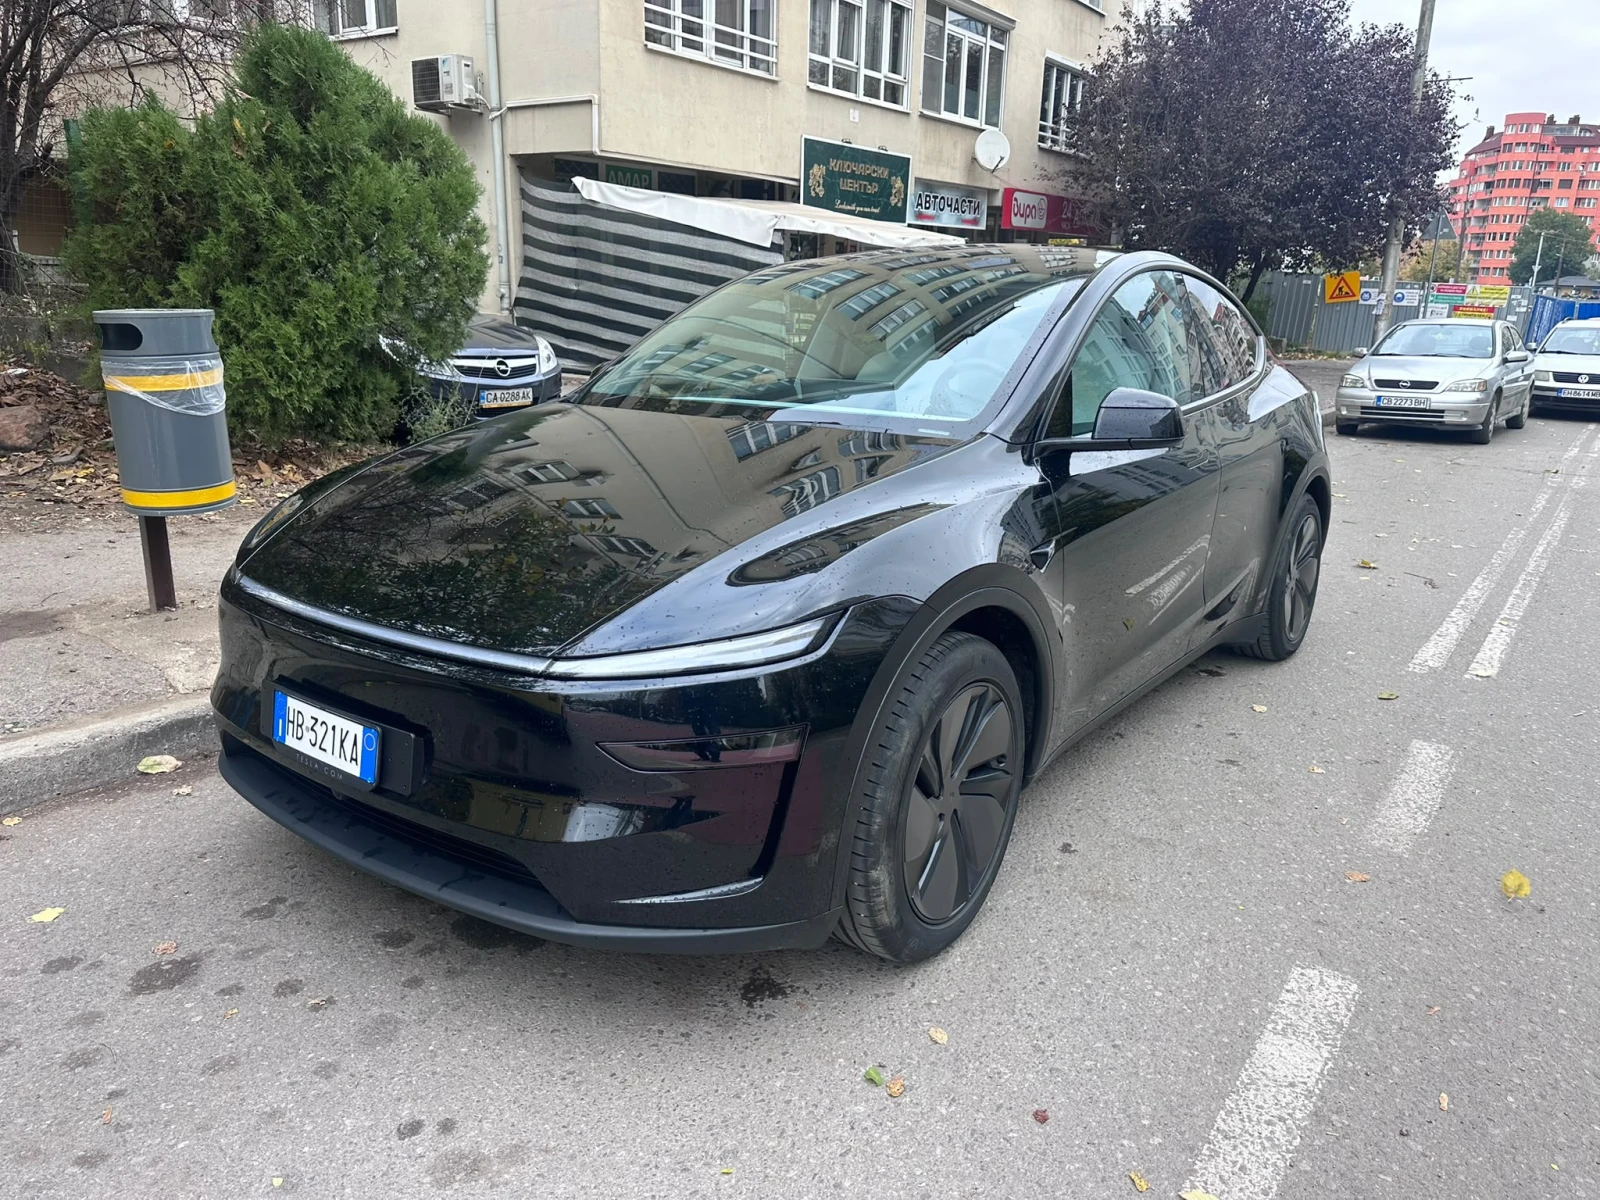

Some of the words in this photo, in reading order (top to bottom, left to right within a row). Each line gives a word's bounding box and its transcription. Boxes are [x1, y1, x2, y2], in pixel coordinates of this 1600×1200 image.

[829, 158, 890, 179] КЛЮЧАРСКИ
[839, 178, 878, 194] ЦЕНТЪР
[915, 192, 981, 216] АВТОЧАСТИ
[500, 391, 520, 402] 0288
[1393, 398, 1413, 406] 2273
